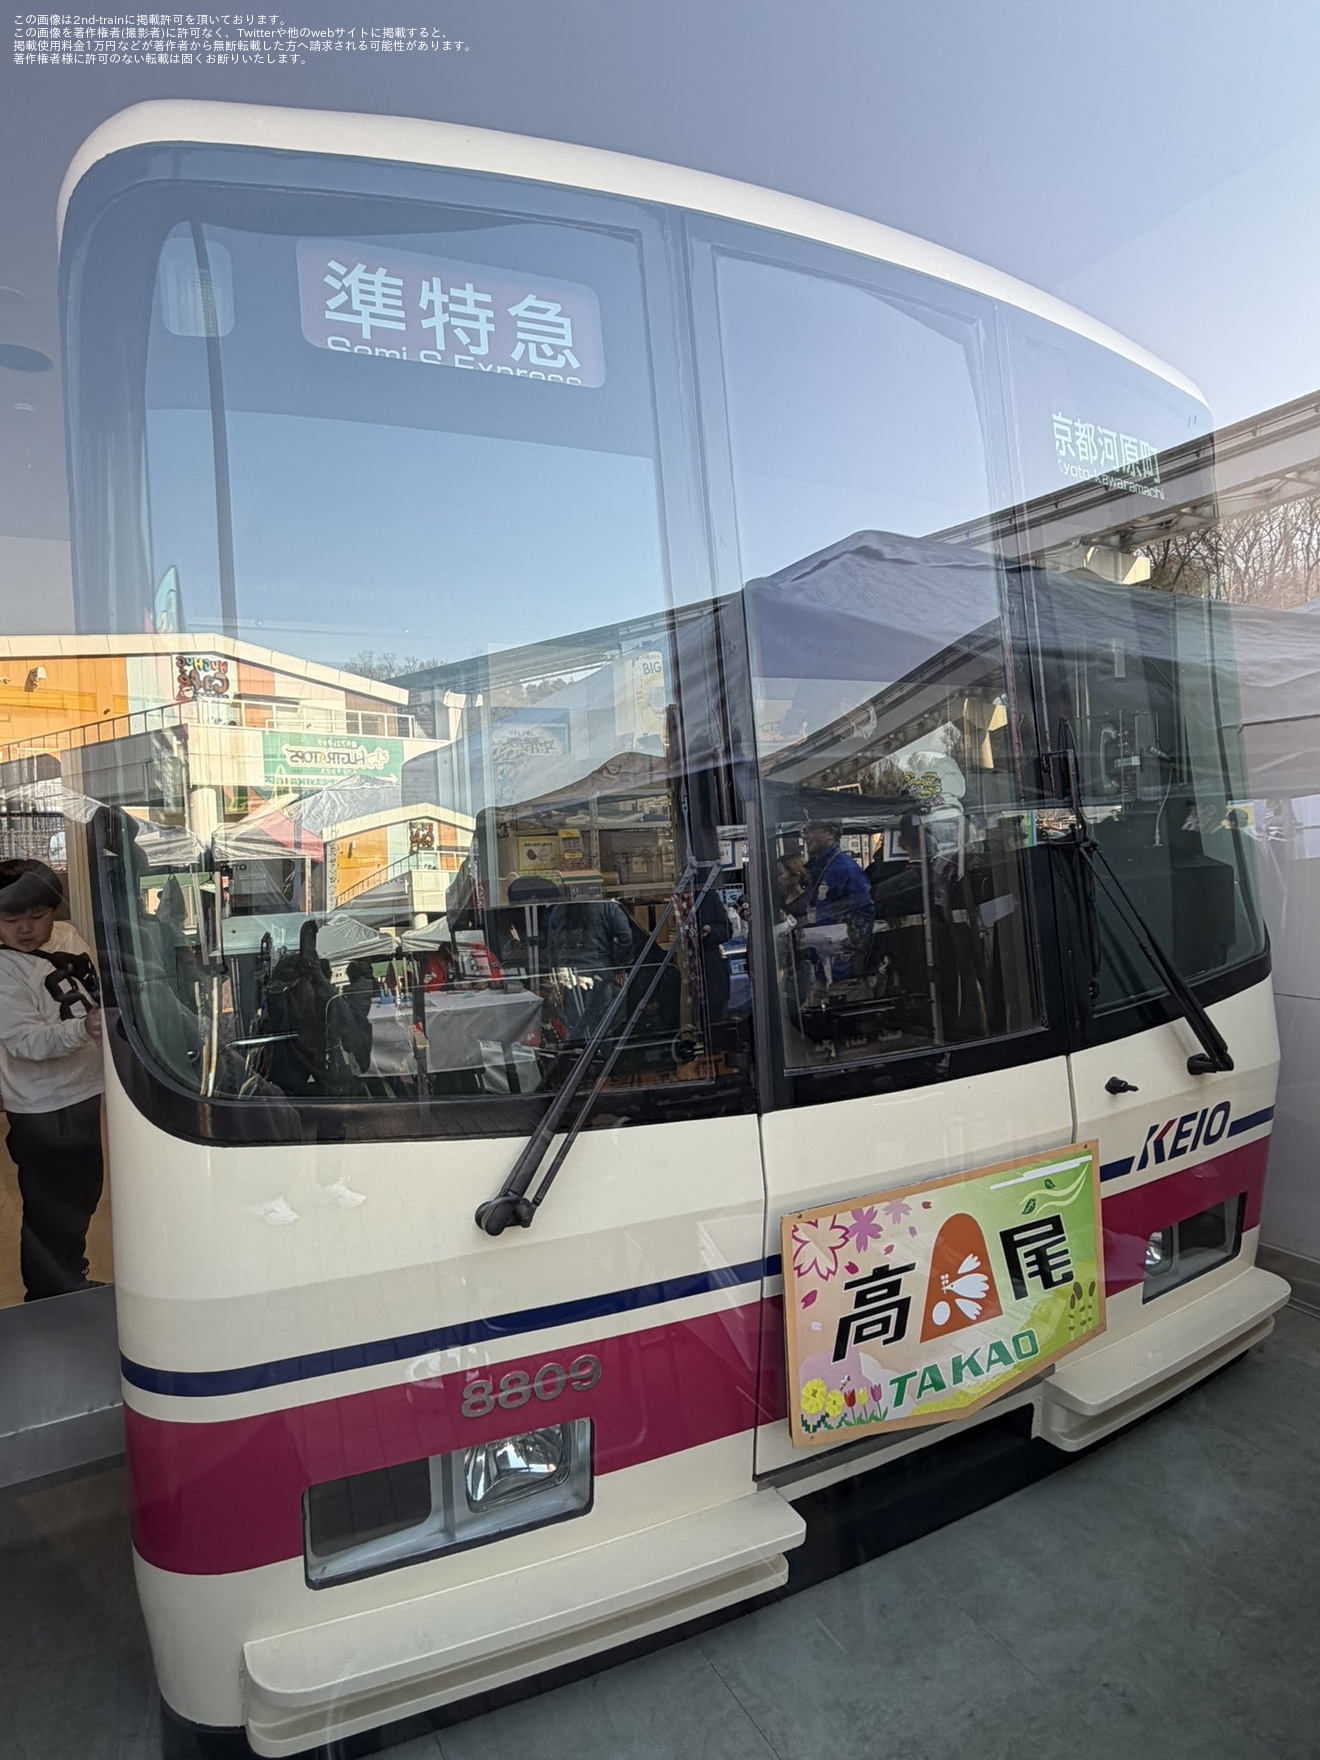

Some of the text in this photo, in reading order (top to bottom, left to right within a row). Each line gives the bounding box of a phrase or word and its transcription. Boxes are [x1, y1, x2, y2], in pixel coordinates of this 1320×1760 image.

[323, 259, 581, 370] 準特急
[1052, 412, 1161, 484] 京都河原町
[1136, 1100, 1232, 1171] KEIO
[460, 1353, 602, 1418] 8809
[888, 1328, 1041, 1409] TAKAO
